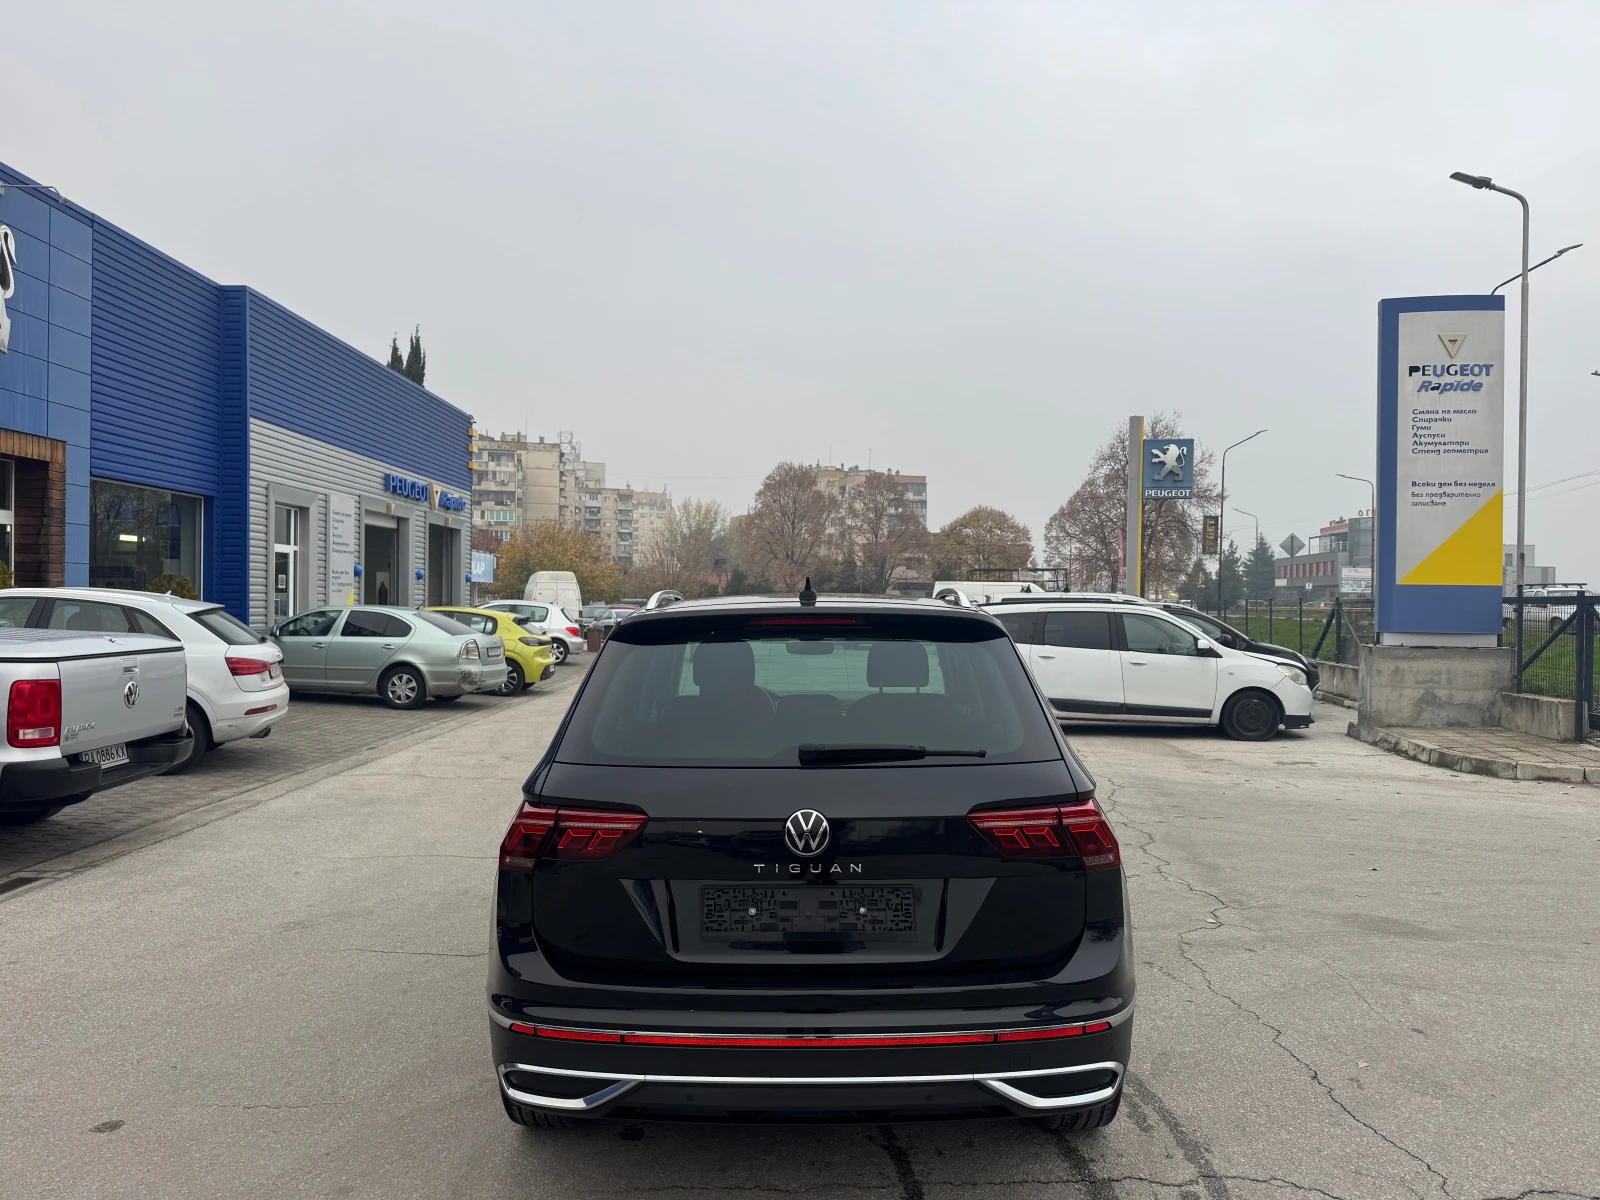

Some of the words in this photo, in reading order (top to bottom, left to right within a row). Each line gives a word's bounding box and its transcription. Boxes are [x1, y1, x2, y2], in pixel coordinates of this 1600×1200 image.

[1408, 363, 1494, 377] PEUGEOT
[1411, 416, 1452, 424] Спирачки
[1411, 424, 1431, 432] Гуми
[1411, 432, 1445, 440] Ауспуси
[1411, 440, 1470, 448] Акумулатори
[388, 474, 430, 502] PEUGEOT
[1145, 489, 1192, 497] PEUGEOT
[1425, 491, 1481, 499] предварително
[753, 863, 862, 874] TIGUAN
